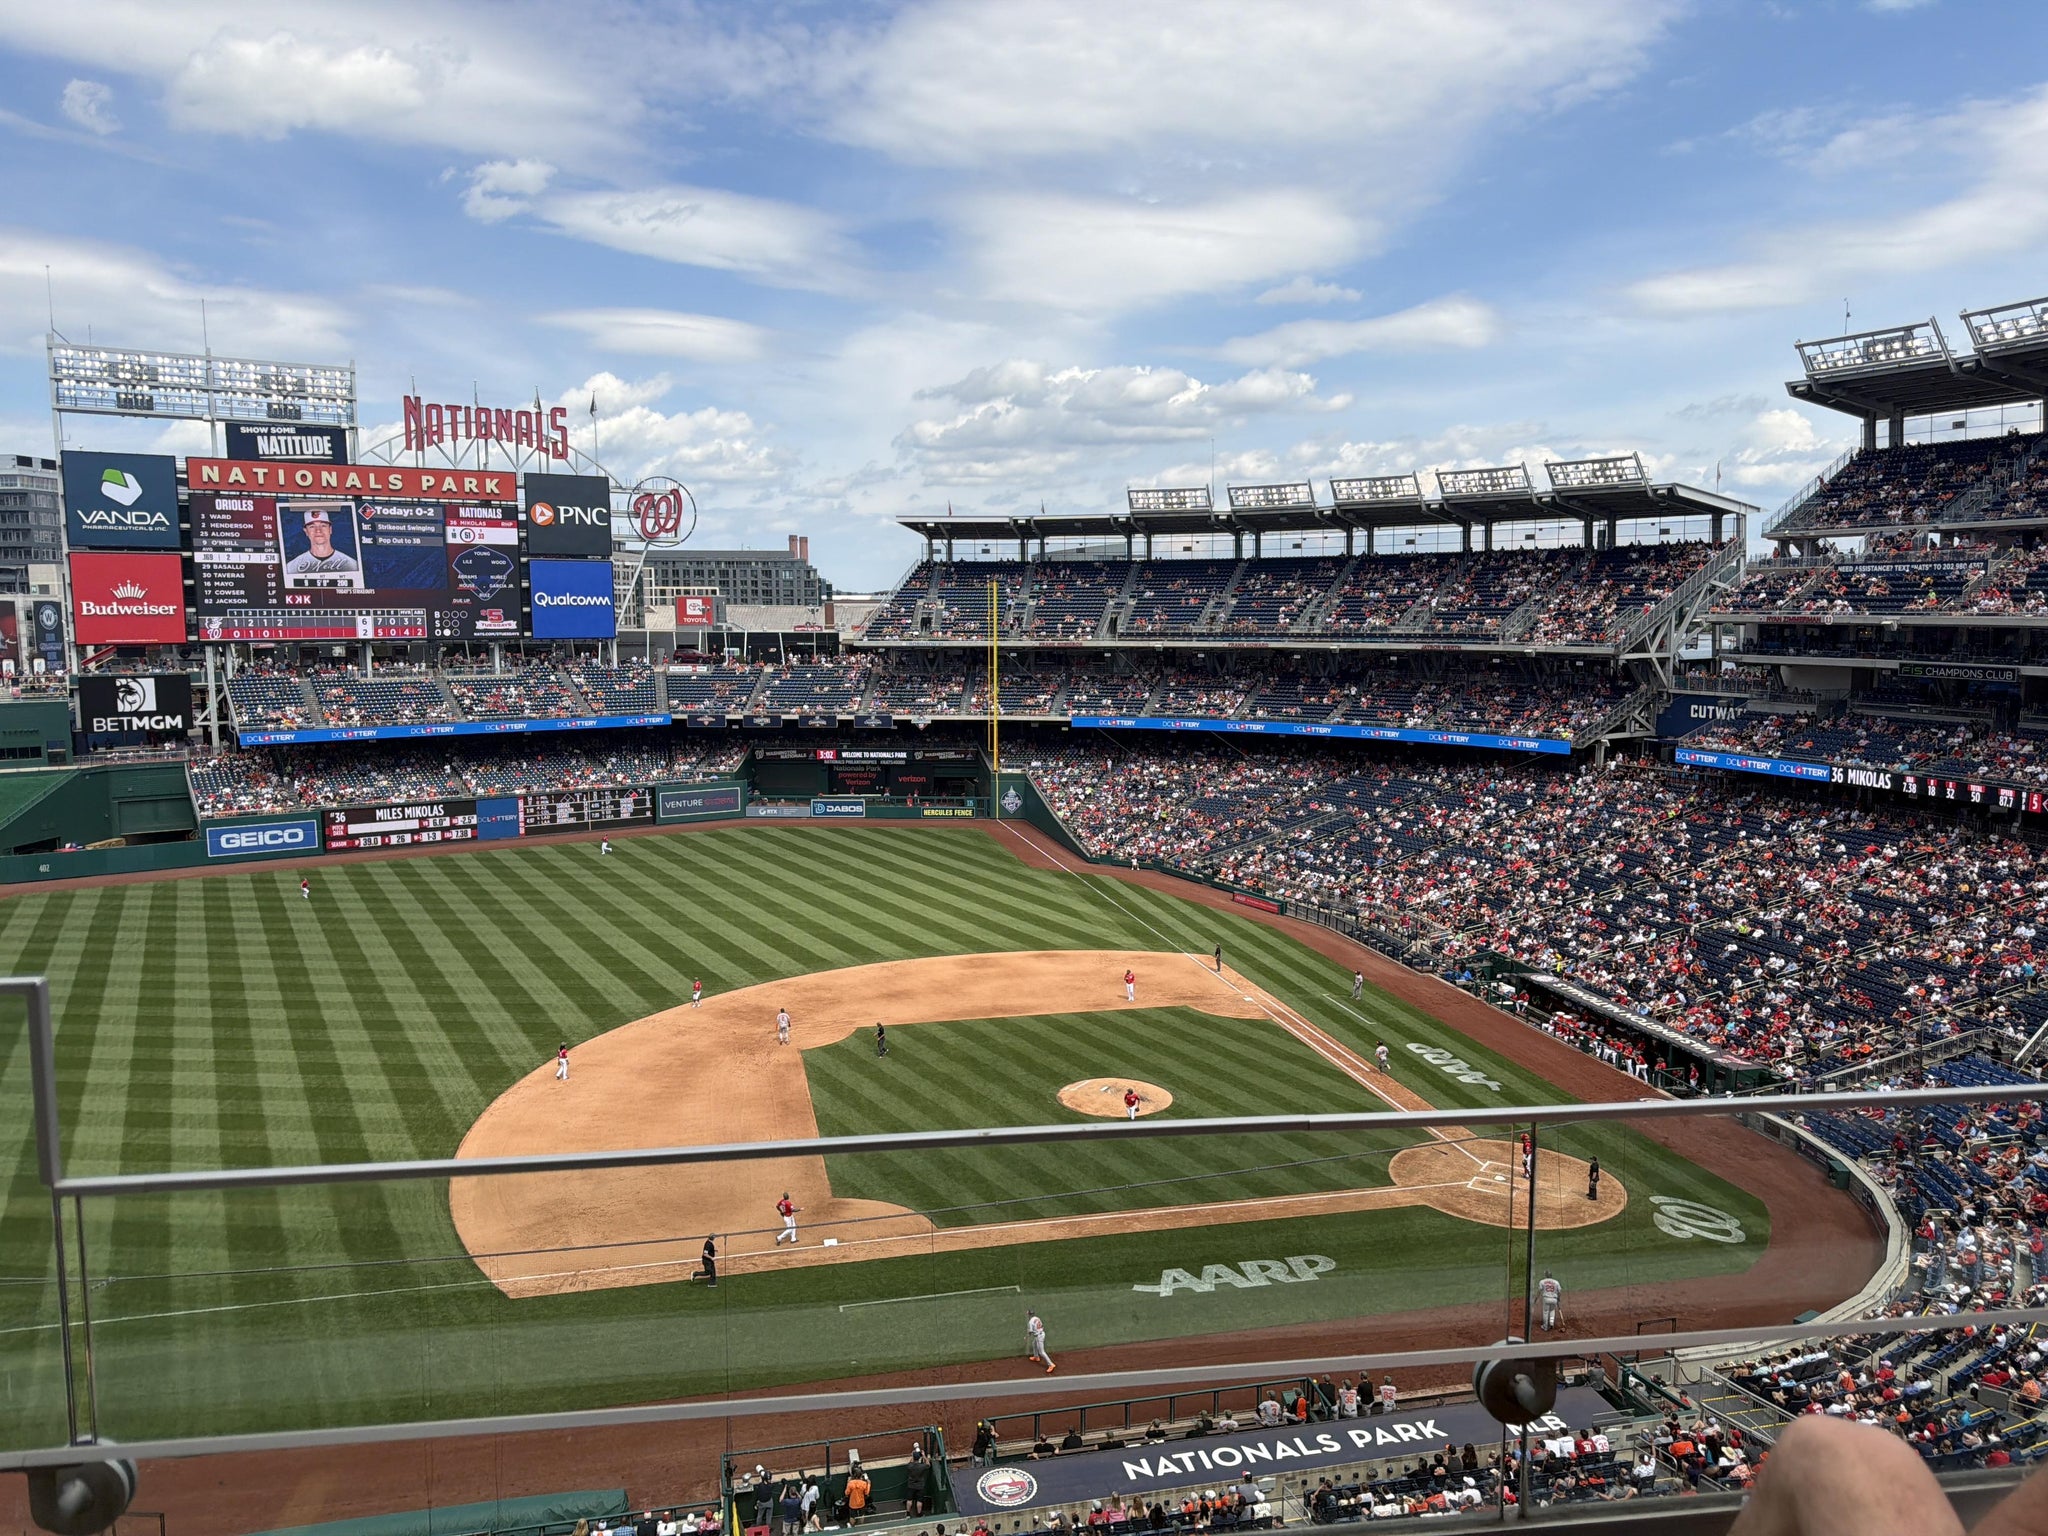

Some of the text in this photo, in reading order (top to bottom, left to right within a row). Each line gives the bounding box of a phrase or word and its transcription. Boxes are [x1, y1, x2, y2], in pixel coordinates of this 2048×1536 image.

[403, 395, 568, 460] NATIONALS
[257, 436, 333, 455] NATITUDE
[201, 465, 501, 494] NATIONALS PARK
[215, 499, 254, 511] ORIOLES
[375, 506, 434, 516] Today: 0-2
[459, 507, 502, 518] NATIONALS
[77, 510, 170, 526] VANDA
[557, 506, 607, 526] PNC
[534, 592, 611, 607] Qualcomm
[80, 601, 178, 616] Budweiser
[1926, 667, 2012, 680] CHAMPIONS CLUB
[93, 715, 183, 732] BETMGM
[820, 751, 834, 759] 3:02
[1832, 767, 1892, 790] 36 MIKOLAS
[1903, 782, 2013, 808] 7.38 18 32 50 87.7
[2032, 796, 2038, 810] 5
[665, 800, 703, 808] VENTURE
[330, 804, 444, 823] #36 MILES MIKOLAS
[220, 828, 304, 848] GEICO
[363, 836, 379, 846] 39.0
[396, 834, 406, 843] 26
[428, 833, 436, 841] 1-3
[456, 830, 468, 838] 7.38
[39, 864, 50, 872] 402
[1553, 983, 1716, 1054] WASHINGTON NATIONALS
[1406, 1043, 1502, 1091] AARP
[1132, 1254, 1336, 1297] AARP
[1272, 1408, 1278, 1417] 3
[1122, 1419, 1448, 1480] NATIONALS PARK
